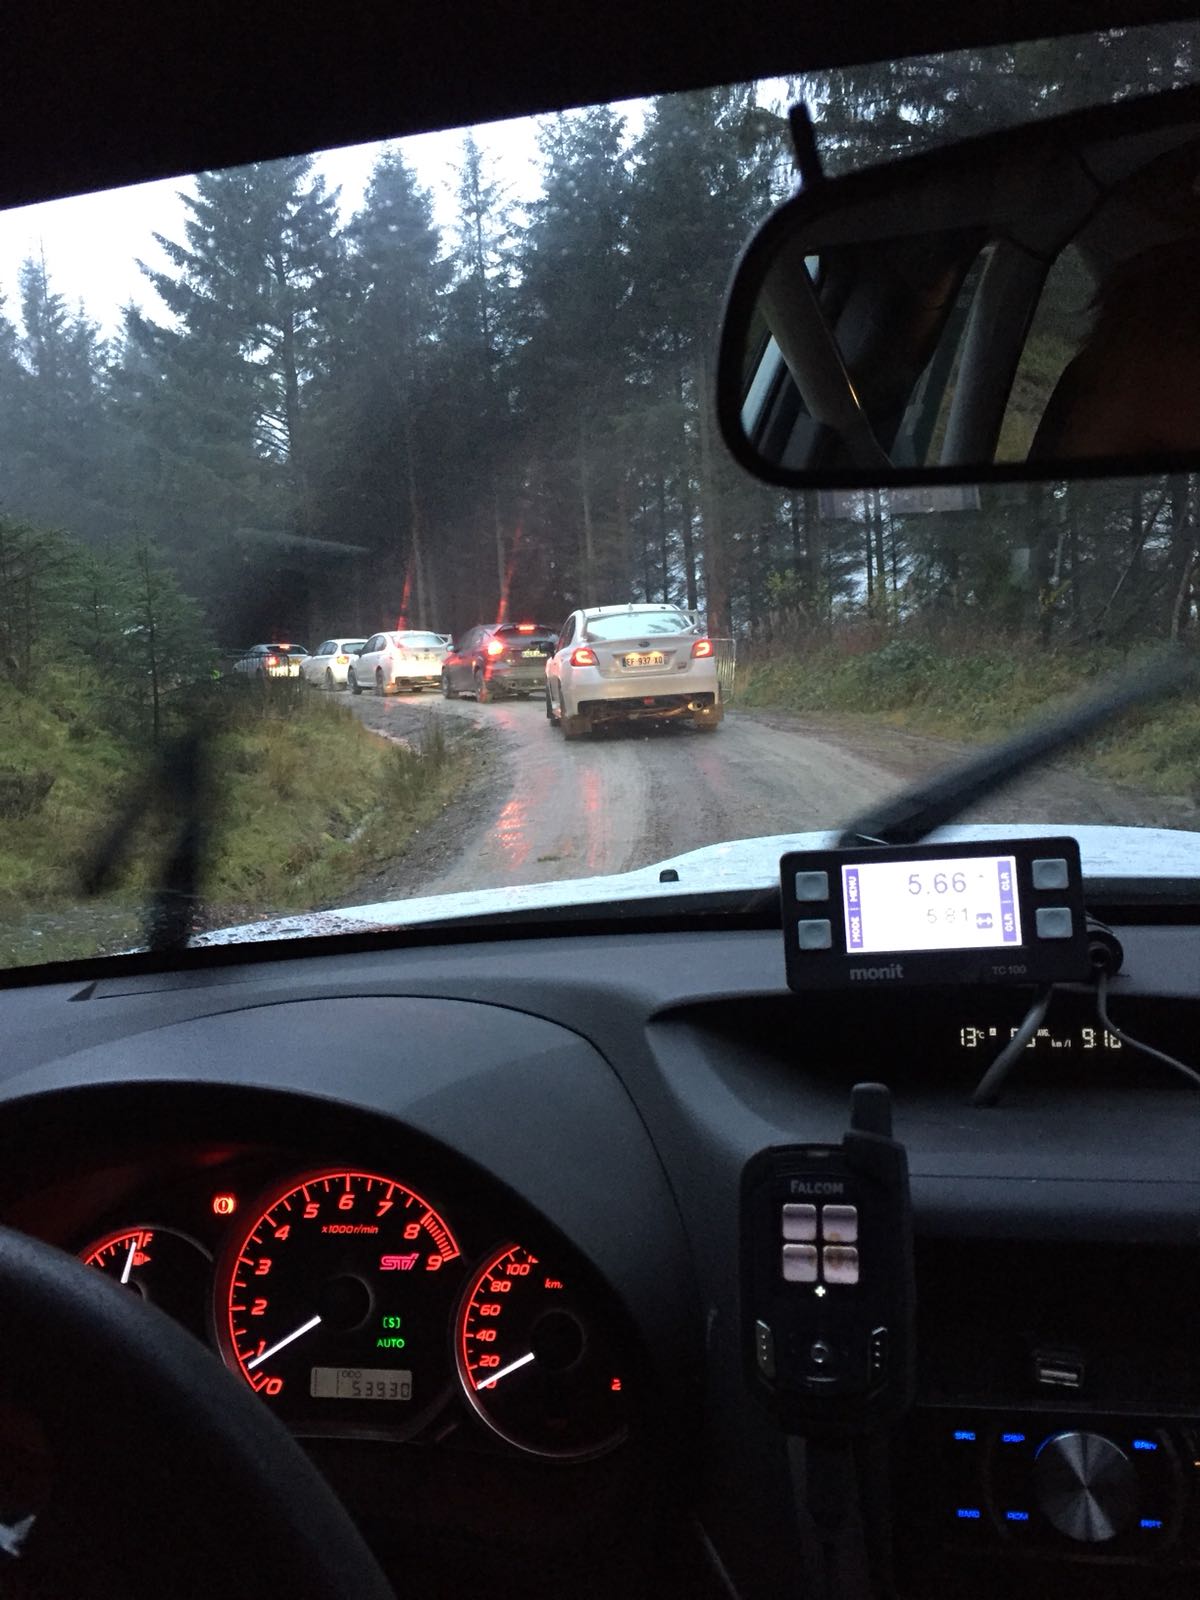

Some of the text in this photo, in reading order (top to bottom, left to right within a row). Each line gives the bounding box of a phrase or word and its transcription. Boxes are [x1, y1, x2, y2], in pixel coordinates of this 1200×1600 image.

[848, 876, 858, 902] MENU
[908, 872, 967, 895] 5.66
[1001, 872, 1010, 891] CLR
[850, 917, 860, 943] MODE
[1004, 913, 1013, 932] CLR
[849, 963, 904, 981] monit
[790, 1180, 844, 1195] FALCOM
[338, 1194, 355, 1210] 6
[377, 1200, 394, 1217] 7
[304, 1203, 320, 1219] 5
[273, 1224, 290, 1241] 4
[403, 1223, 421, 1240] 8
[254, 1258, 272, 1275] 3
[426, 1254, 444, 1271] 9
[506, 1263, 531, 1276] 100
[490, 1280, 512, 1293] 80
[250, 1299, 268, 1316] 2
[480, 1304, 501, 1317] 60
[376, 1338, 405, 1349] AUTO
[475, 1330, 497, 1342] 40
[479, 1355, 500, 1367] 20
[265, 1378, 283, 1395] 0
